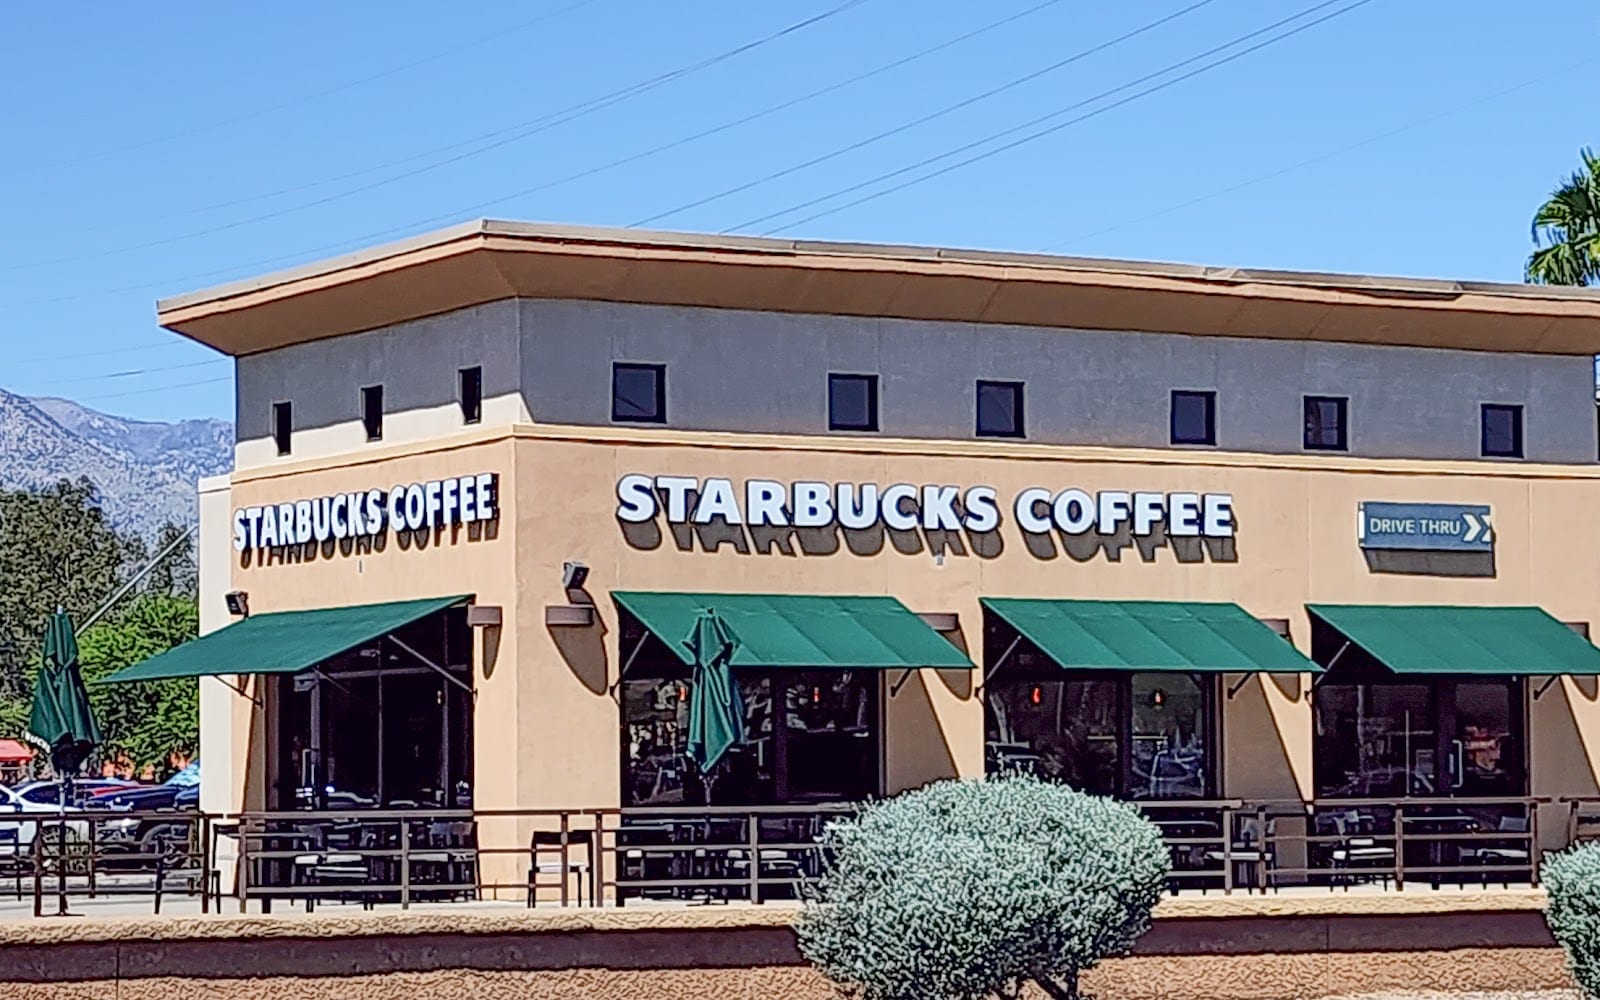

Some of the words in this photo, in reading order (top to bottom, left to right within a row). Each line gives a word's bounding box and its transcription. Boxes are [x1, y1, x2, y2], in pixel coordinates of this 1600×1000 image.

[233, 489, 386, 551] STARBUCKS
[388, 473, 495, 531] COFFEE
[616, 474, 998, 533] STARBUCKS
[1015, 487, 1234, 537] COFFEE
[1369, 518, 1416, 534] DRIVE
[1420, 519, 1461, 535] THRU
